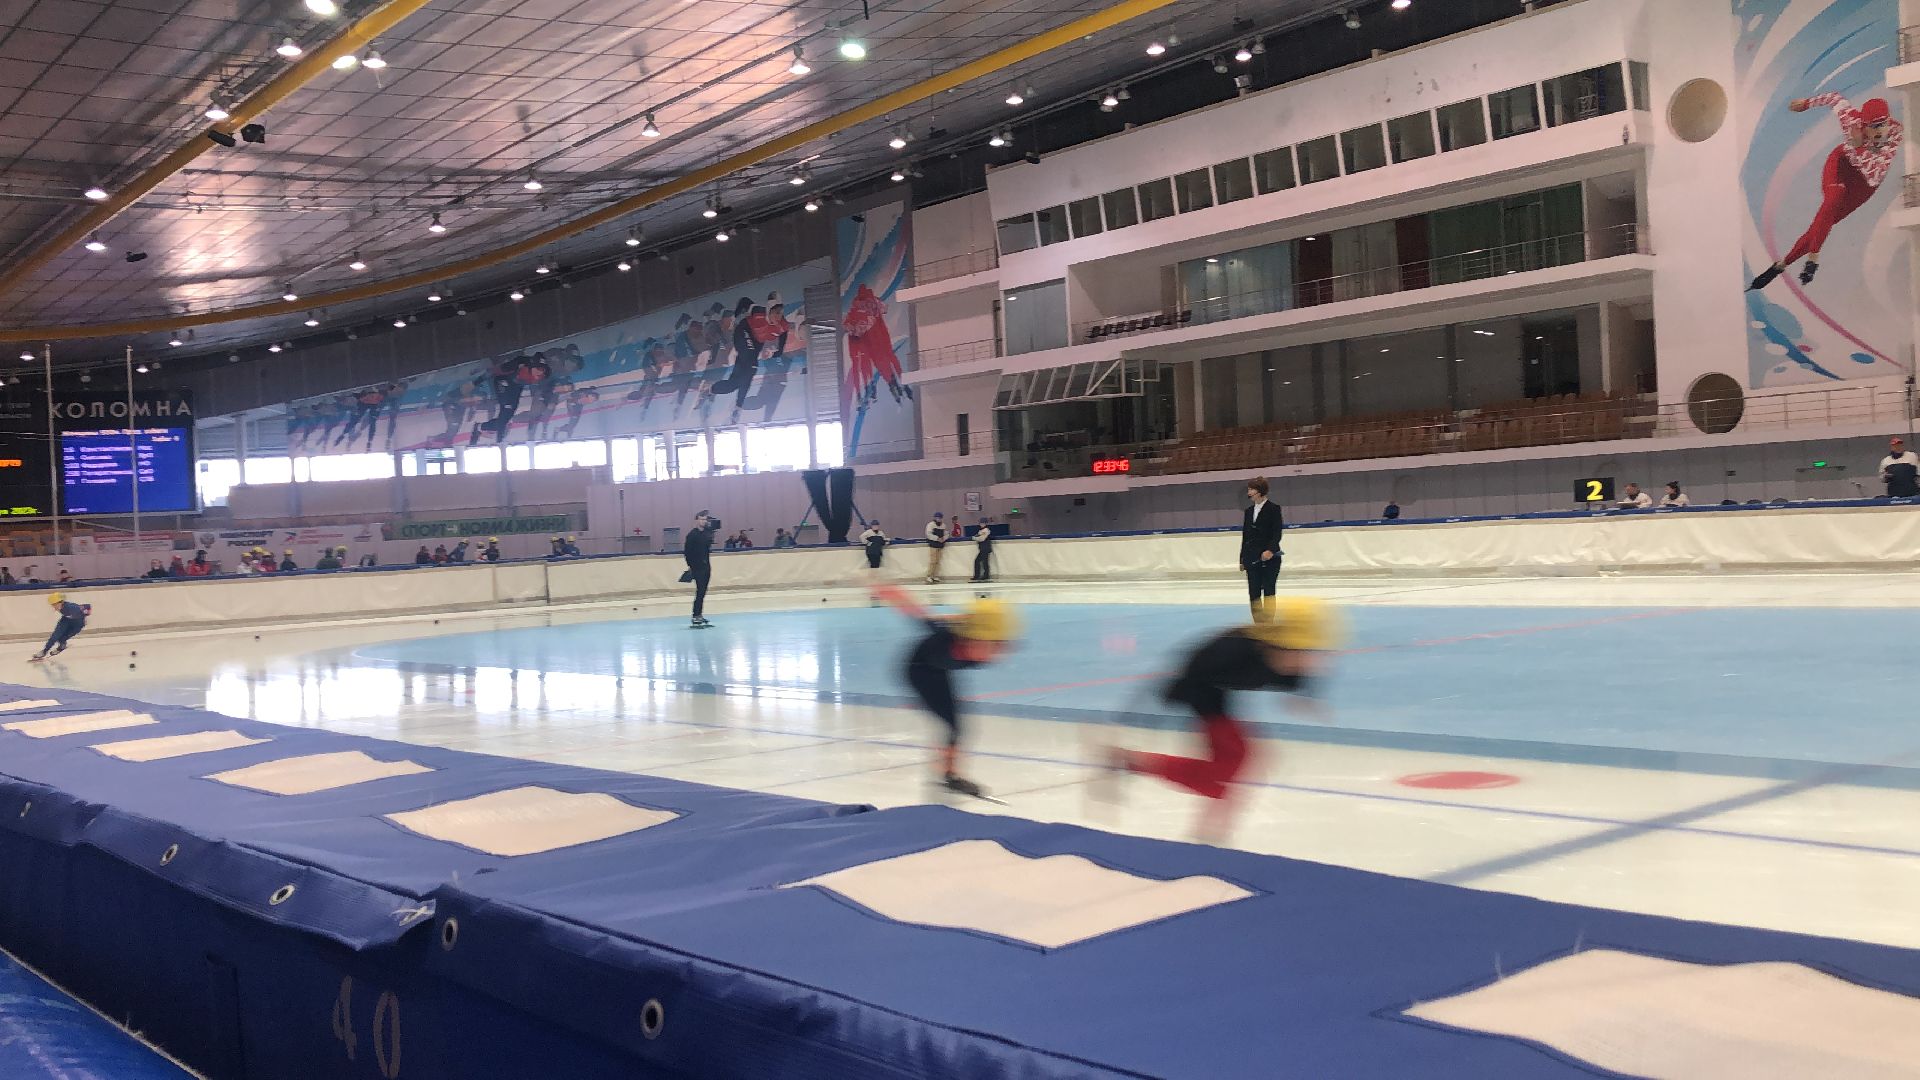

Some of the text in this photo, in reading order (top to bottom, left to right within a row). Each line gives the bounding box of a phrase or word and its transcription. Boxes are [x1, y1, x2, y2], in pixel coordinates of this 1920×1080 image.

[52, 400, 192, 419] КОЛОМНА
[1586, 480, 1604, 501] 2
[332, 975, 400, 1079] 40
